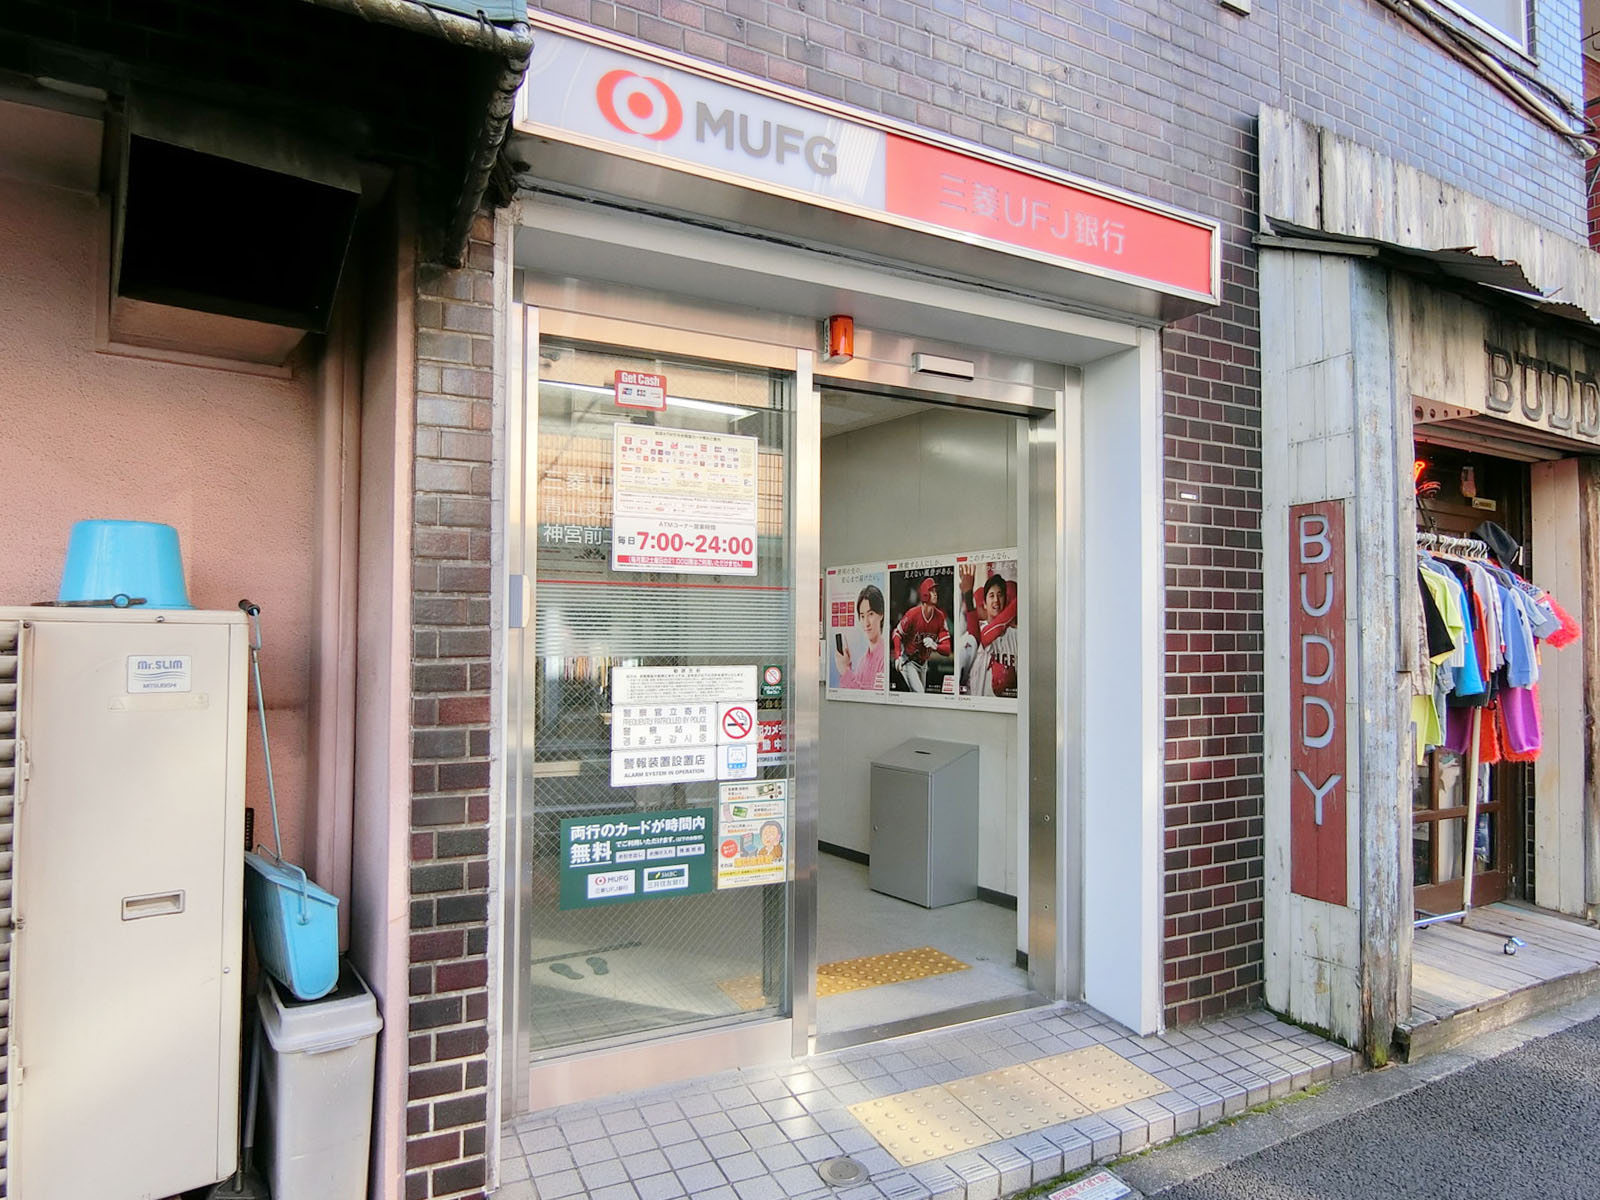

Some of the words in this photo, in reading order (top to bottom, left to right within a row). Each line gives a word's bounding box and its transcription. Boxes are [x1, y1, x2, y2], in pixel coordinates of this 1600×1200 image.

[695, 100, 838, 176] MUFG
[938, 171, 1128, 257] 三菱UFJ銀行
[621, 372, 637, 384] Get
[638, 374, 660, 387] Cash
[617, 535, 636, 546] 毎日
[1297, 514, 1342, 827] BUDDY
[624, 755, 705, 769] 警報装置設置店
[570, 816, 706, 841] 両行のカードが時間内
[570, 841, 612, 864] 無料
